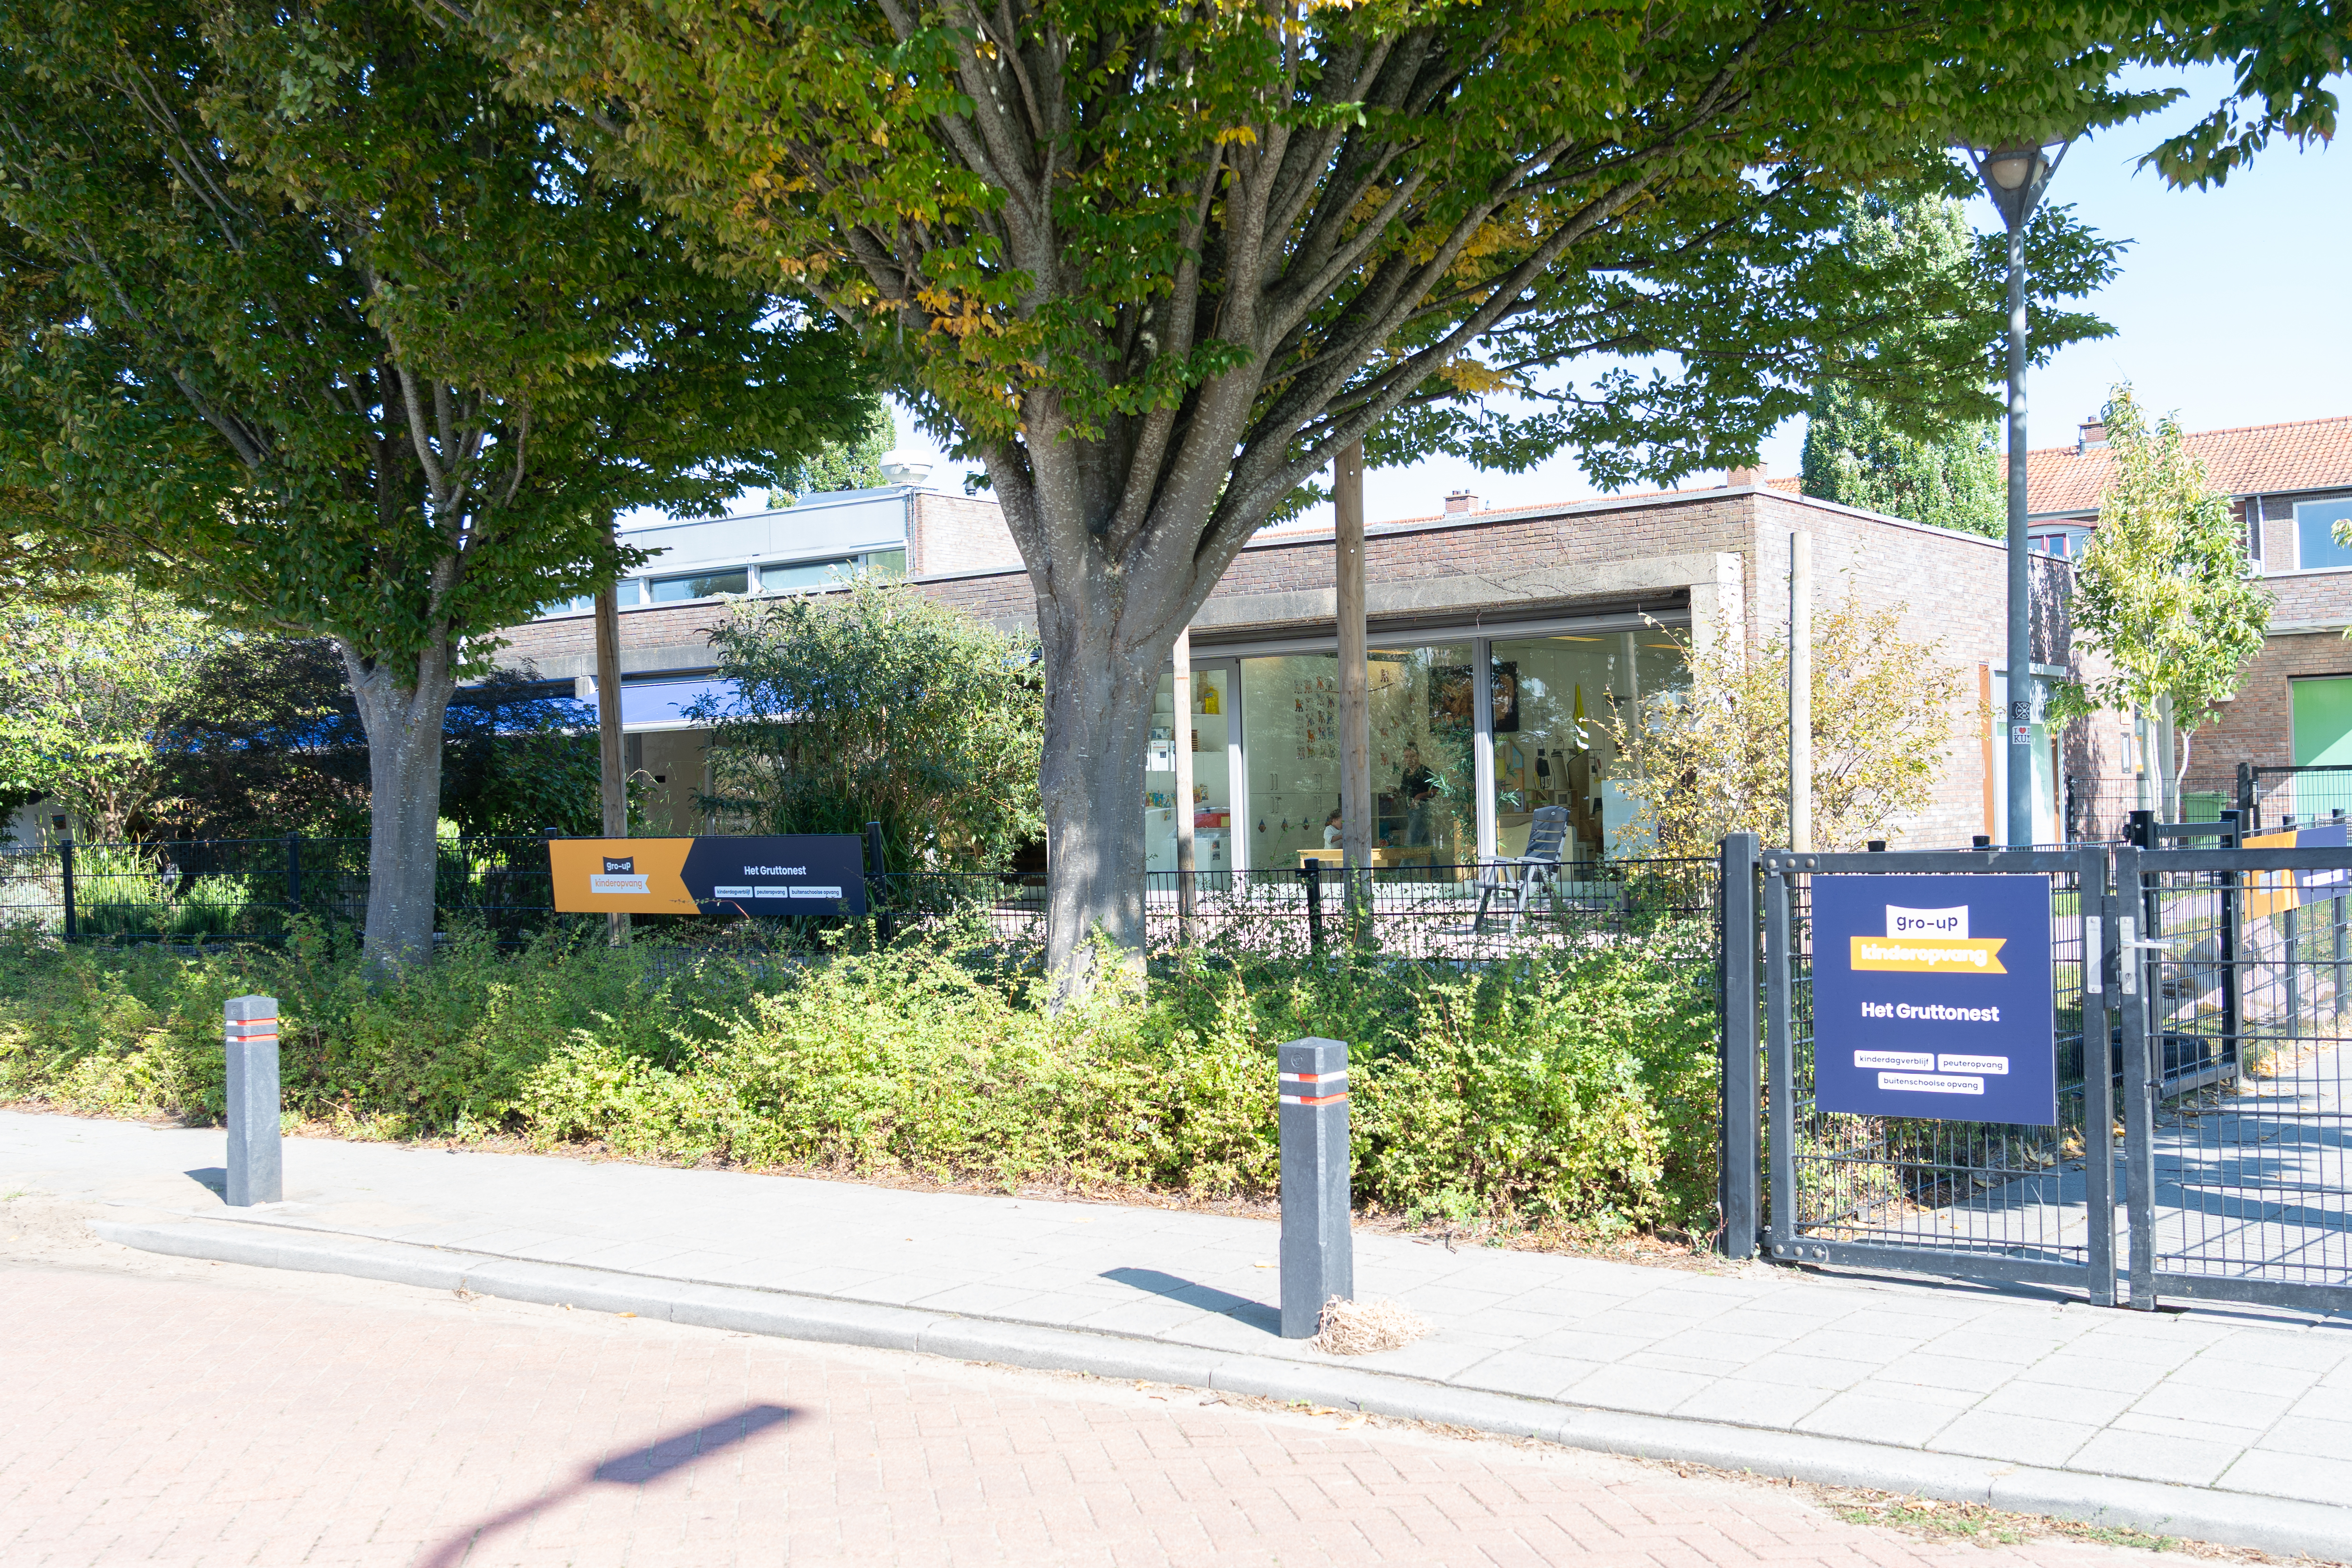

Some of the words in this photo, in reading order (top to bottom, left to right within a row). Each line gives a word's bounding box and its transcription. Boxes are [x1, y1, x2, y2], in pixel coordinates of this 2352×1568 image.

[606, 862, 631, 871] gro-up
[744, 866, 759, 875] Het
[760, 866, 806, 875] Gruttonest
[595, 878, 642, 889] kinderopvang
[1897, 917, 1958, 931] gro-up
[1861, 943, 1988, 967] kinderopvang
[1861, 1002, 1894, 1018] Het
[1896, 1003, 2000, 1022] Gruttonest
[1860, 1055, 1929, 1066] kinderdagverblijf
[1943, 1060, 2003, 1070] peuteropvang
[1884, 1077, 1945, 1086] buitenschoolse
[1947, 1081, 1978, 1091] opvang
